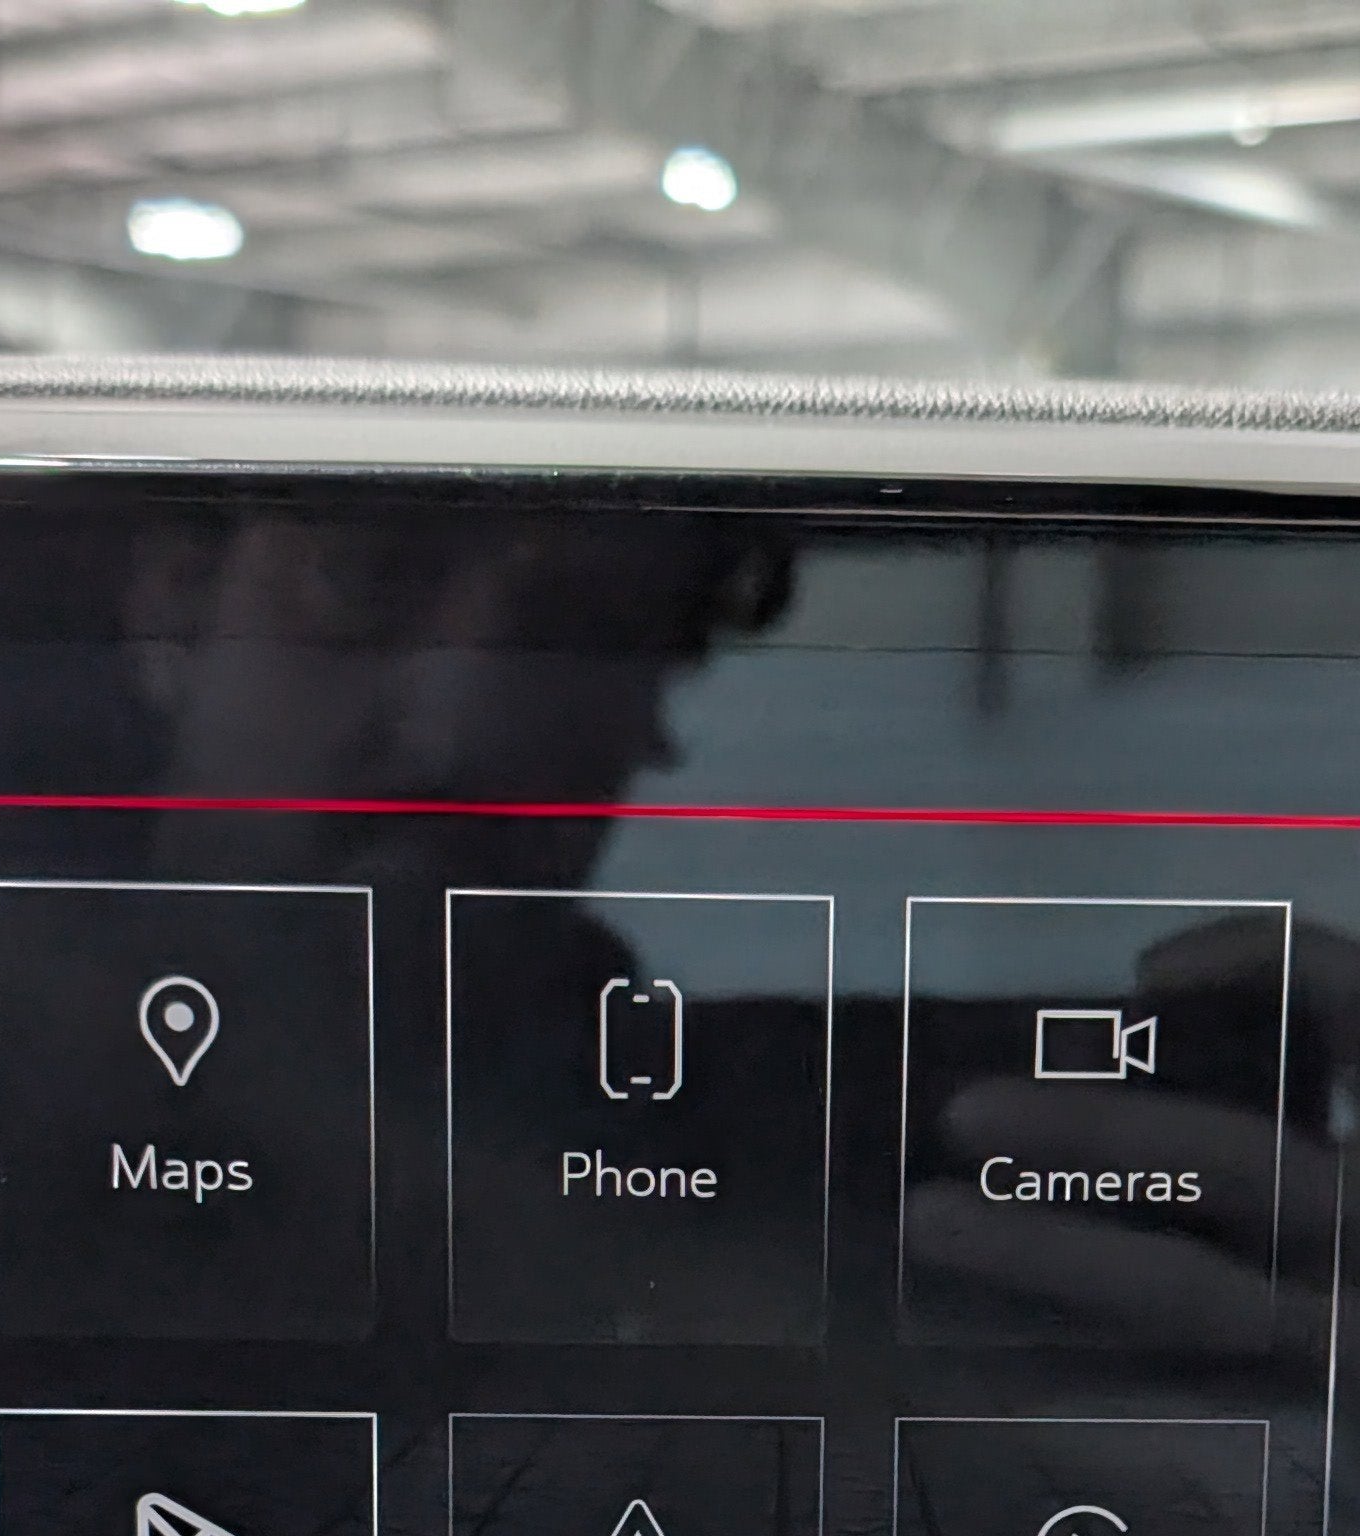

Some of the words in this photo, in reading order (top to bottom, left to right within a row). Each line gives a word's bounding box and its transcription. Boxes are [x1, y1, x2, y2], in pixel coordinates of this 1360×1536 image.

[112, 1143, 253, 1202] Maps
[562, 1150, 718, 1199] Phone
[980, 1156, 1202, 1203] Cameras
